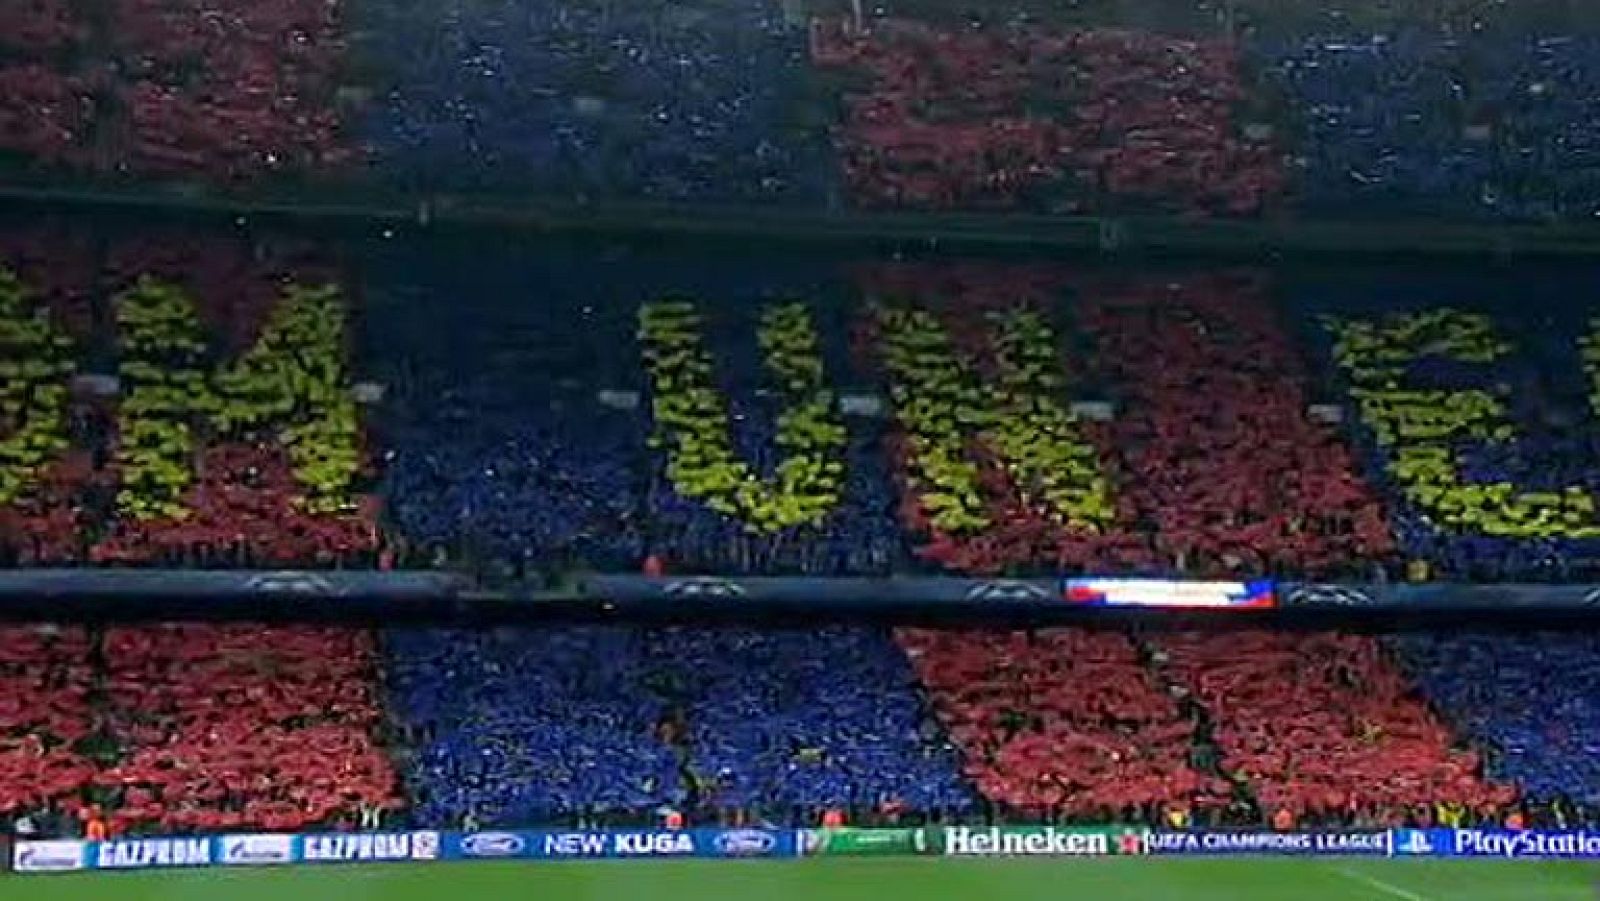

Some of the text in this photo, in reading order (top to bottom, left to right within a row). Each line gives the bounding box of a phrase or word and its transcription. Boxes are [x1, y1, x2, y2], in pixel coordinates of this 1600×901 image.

[98, 838, 210, 868] GAZPROM
[303, 833, 409, 860] GAZPROM
[545, 834, 606, 854] NEW
[613, 834, 693, 852] KUGA
[945, 826, 1108, 855] Heineken
[1149, 833, 1384, 850] UEFA CHAMPIONS LEAGUE
